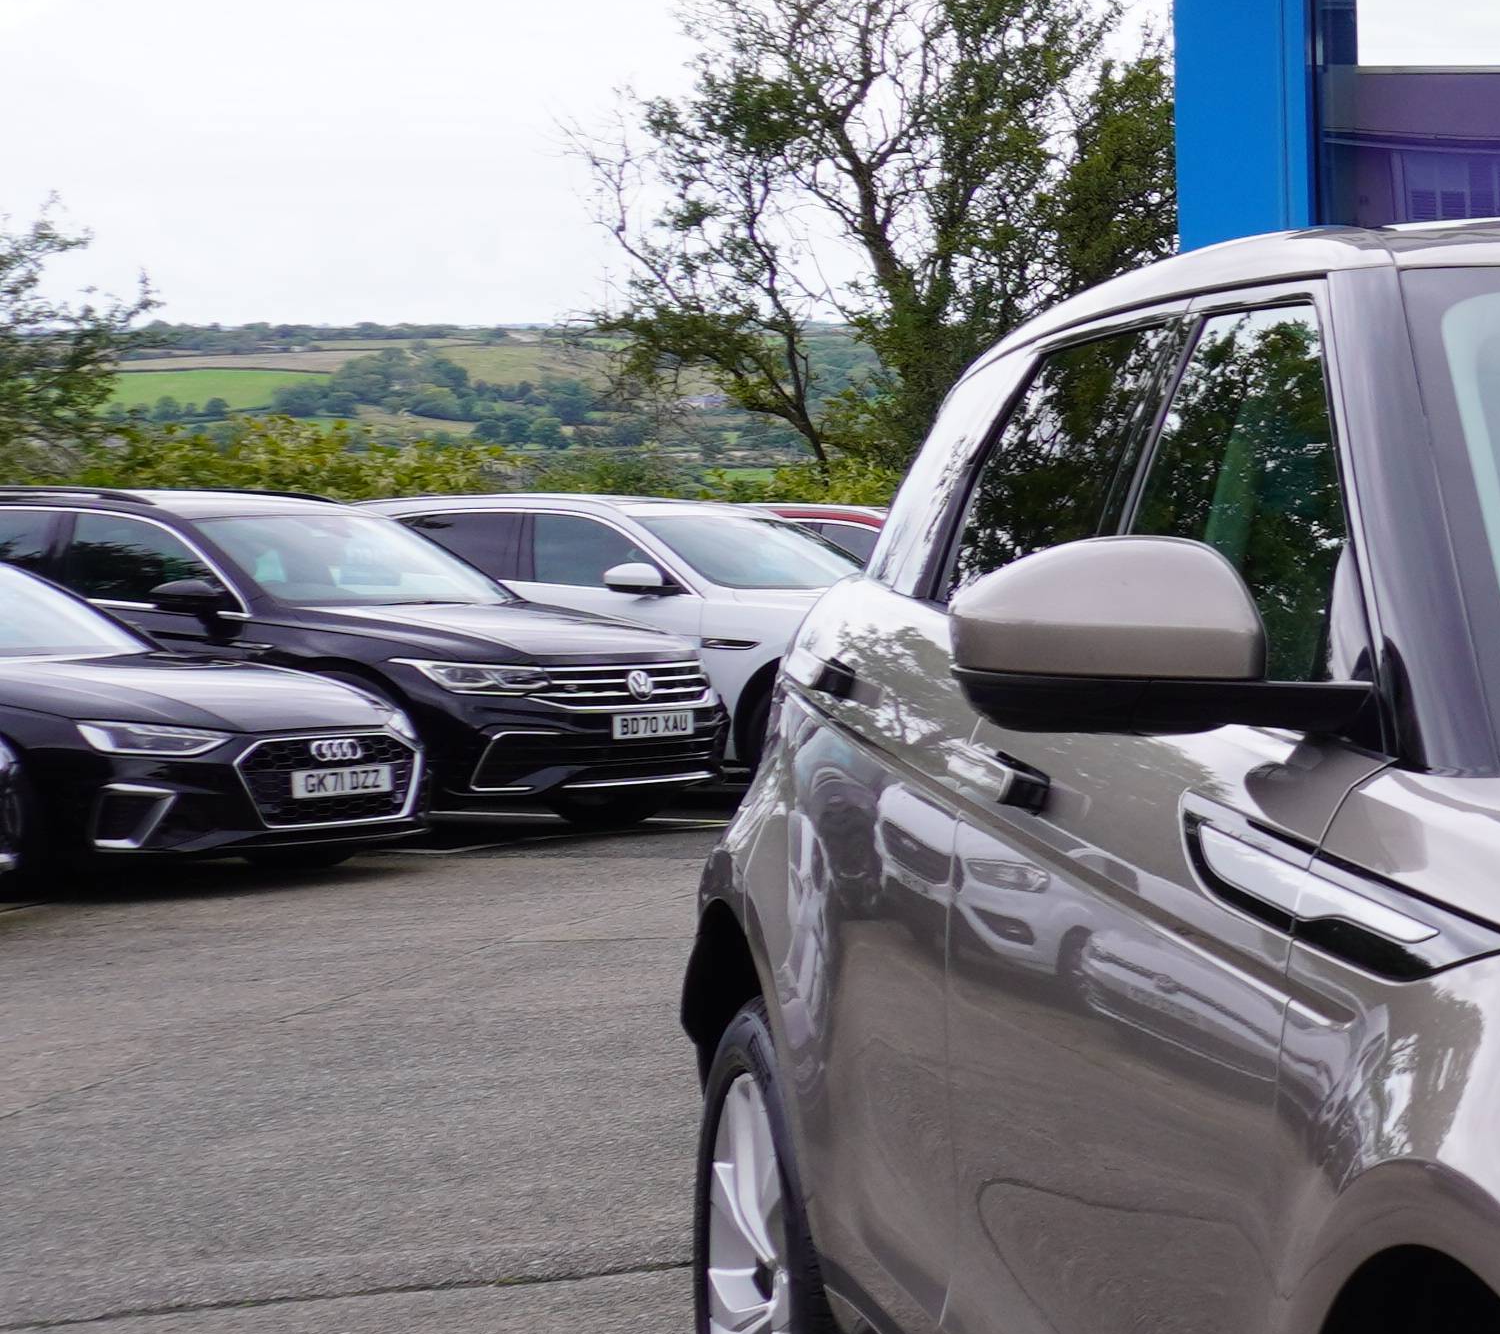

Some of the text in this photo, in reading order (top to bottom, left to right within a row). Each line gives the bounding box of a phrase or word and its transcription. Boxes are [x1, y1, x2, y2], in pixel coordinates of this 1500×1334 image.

[620, 713, 690, 736] BD70 XAU
[304, 769, 382, 793] GK71 DZZ
